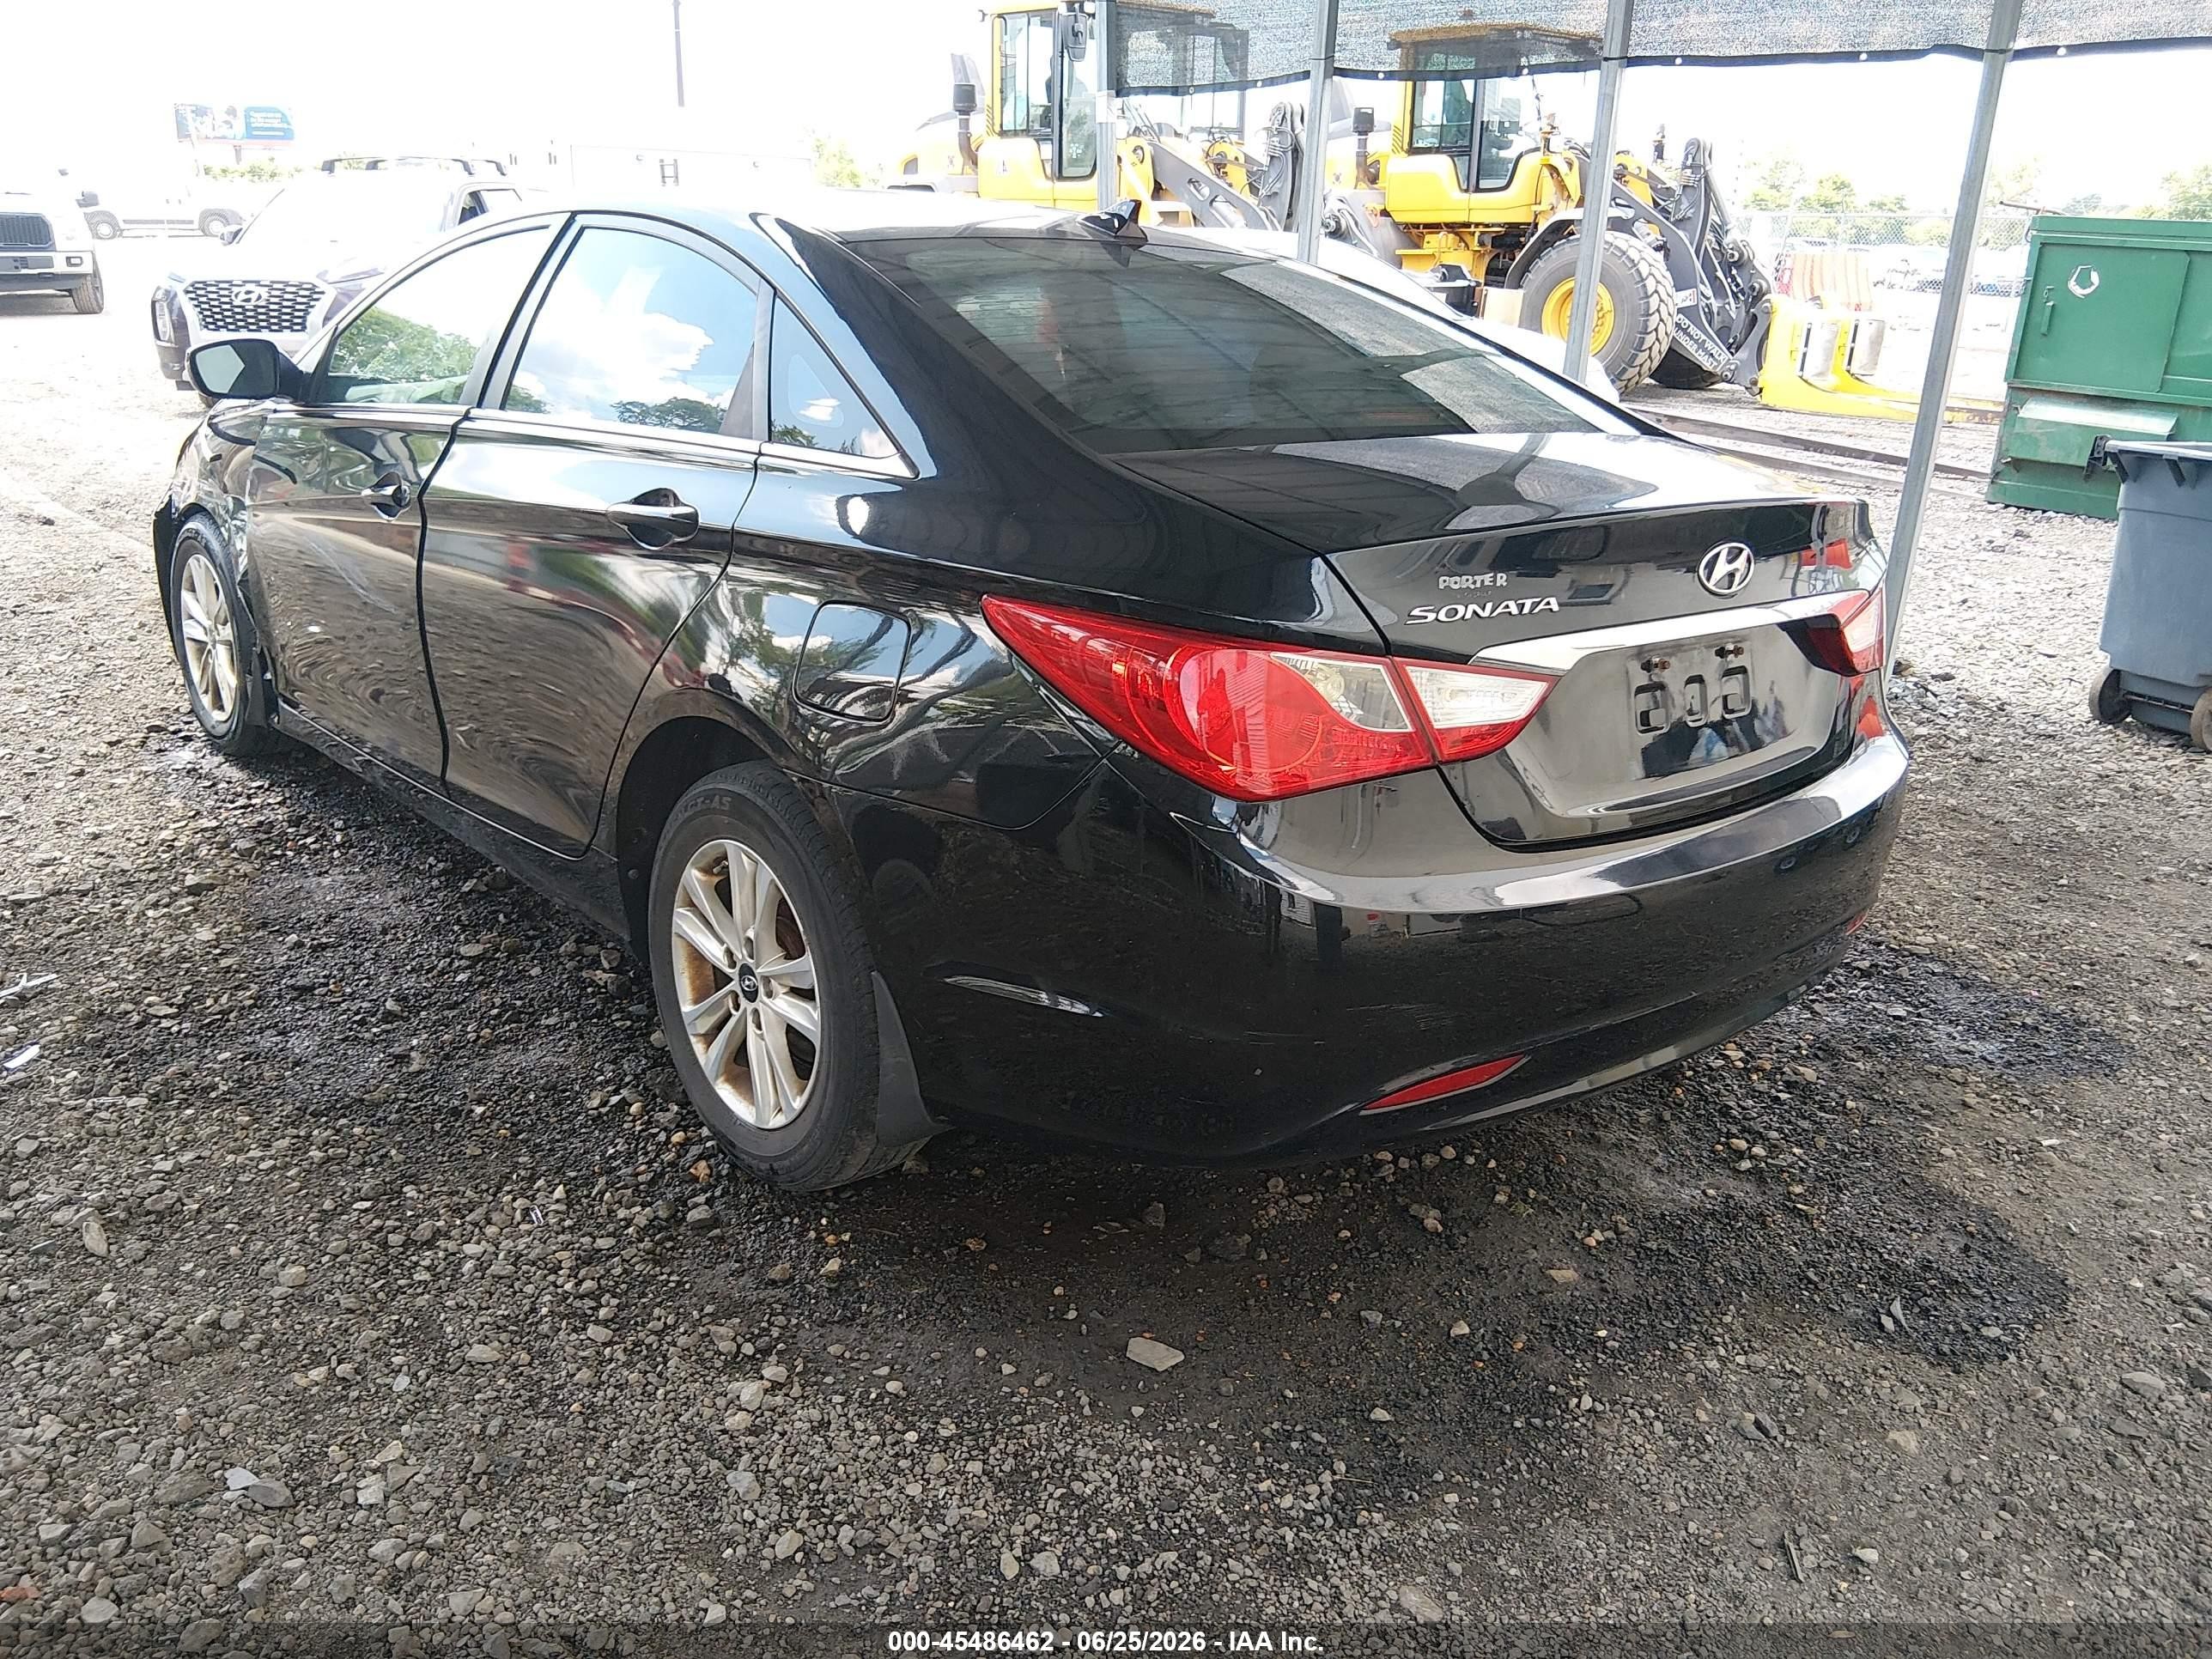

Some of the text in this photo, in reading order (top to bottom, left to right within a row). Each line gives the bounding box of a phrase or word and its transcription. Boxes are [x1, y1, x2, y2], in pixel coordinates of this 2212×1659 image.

[1674, 327, 1718, 369] UNDER MAST
[1676, 313, 1727, 362] DO NOT WALK
[1438, 573, 1508, 590] PORTER
[1405, 597, 1560, 625] SONATA
